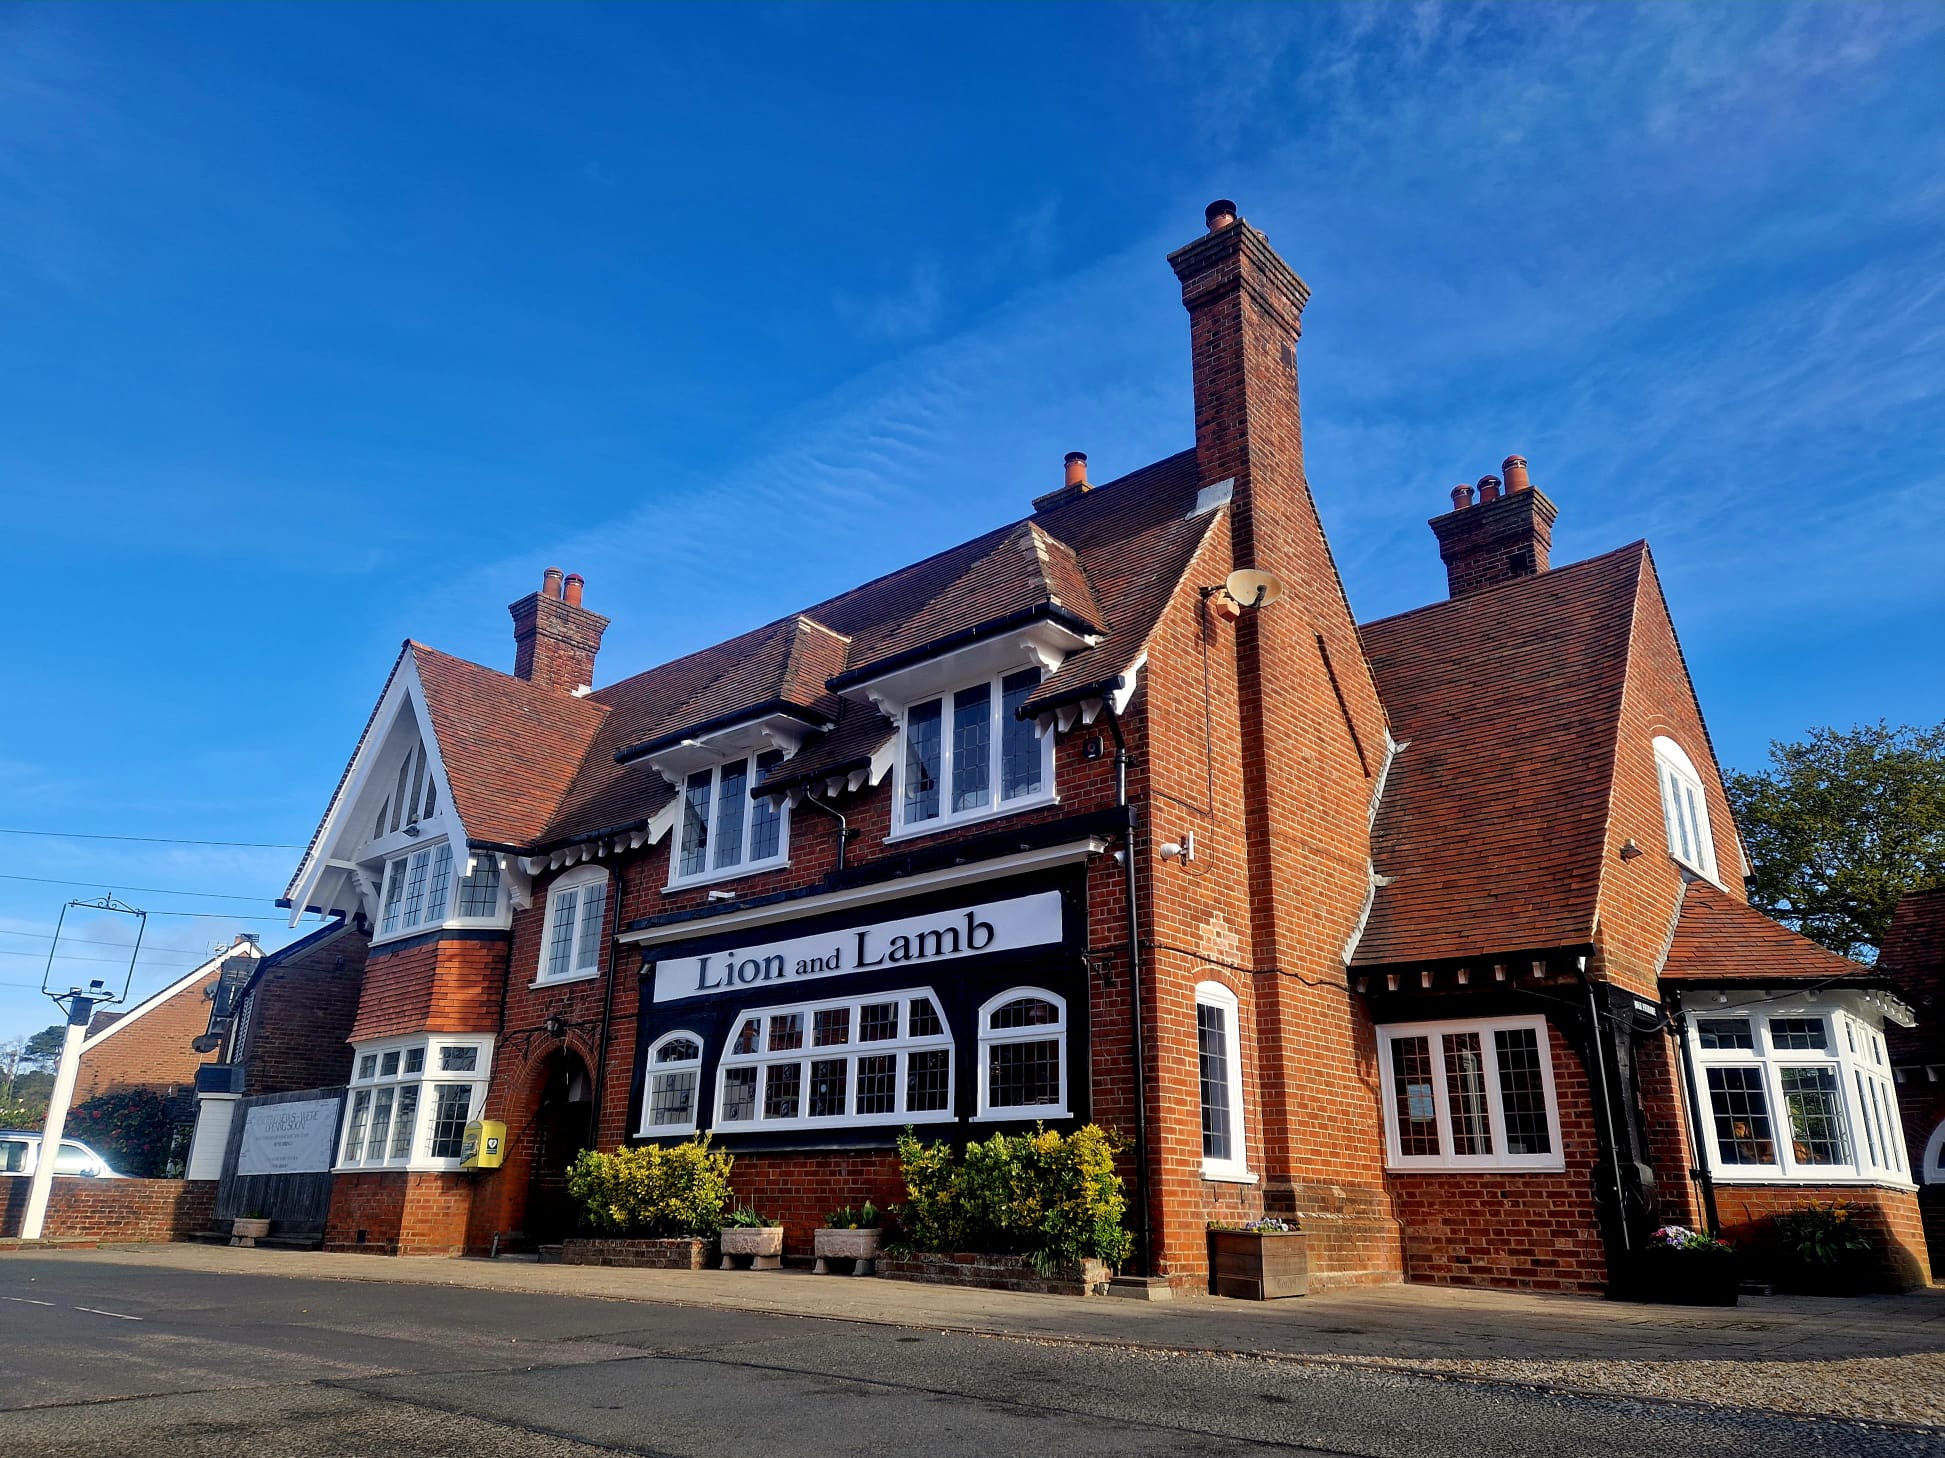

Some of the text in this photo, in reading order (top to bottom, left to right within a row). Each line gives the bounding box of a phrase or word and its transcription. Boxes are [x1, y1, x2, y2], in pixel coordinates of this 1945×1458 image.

[695, 910, 995, 991] Lion and Lamb
